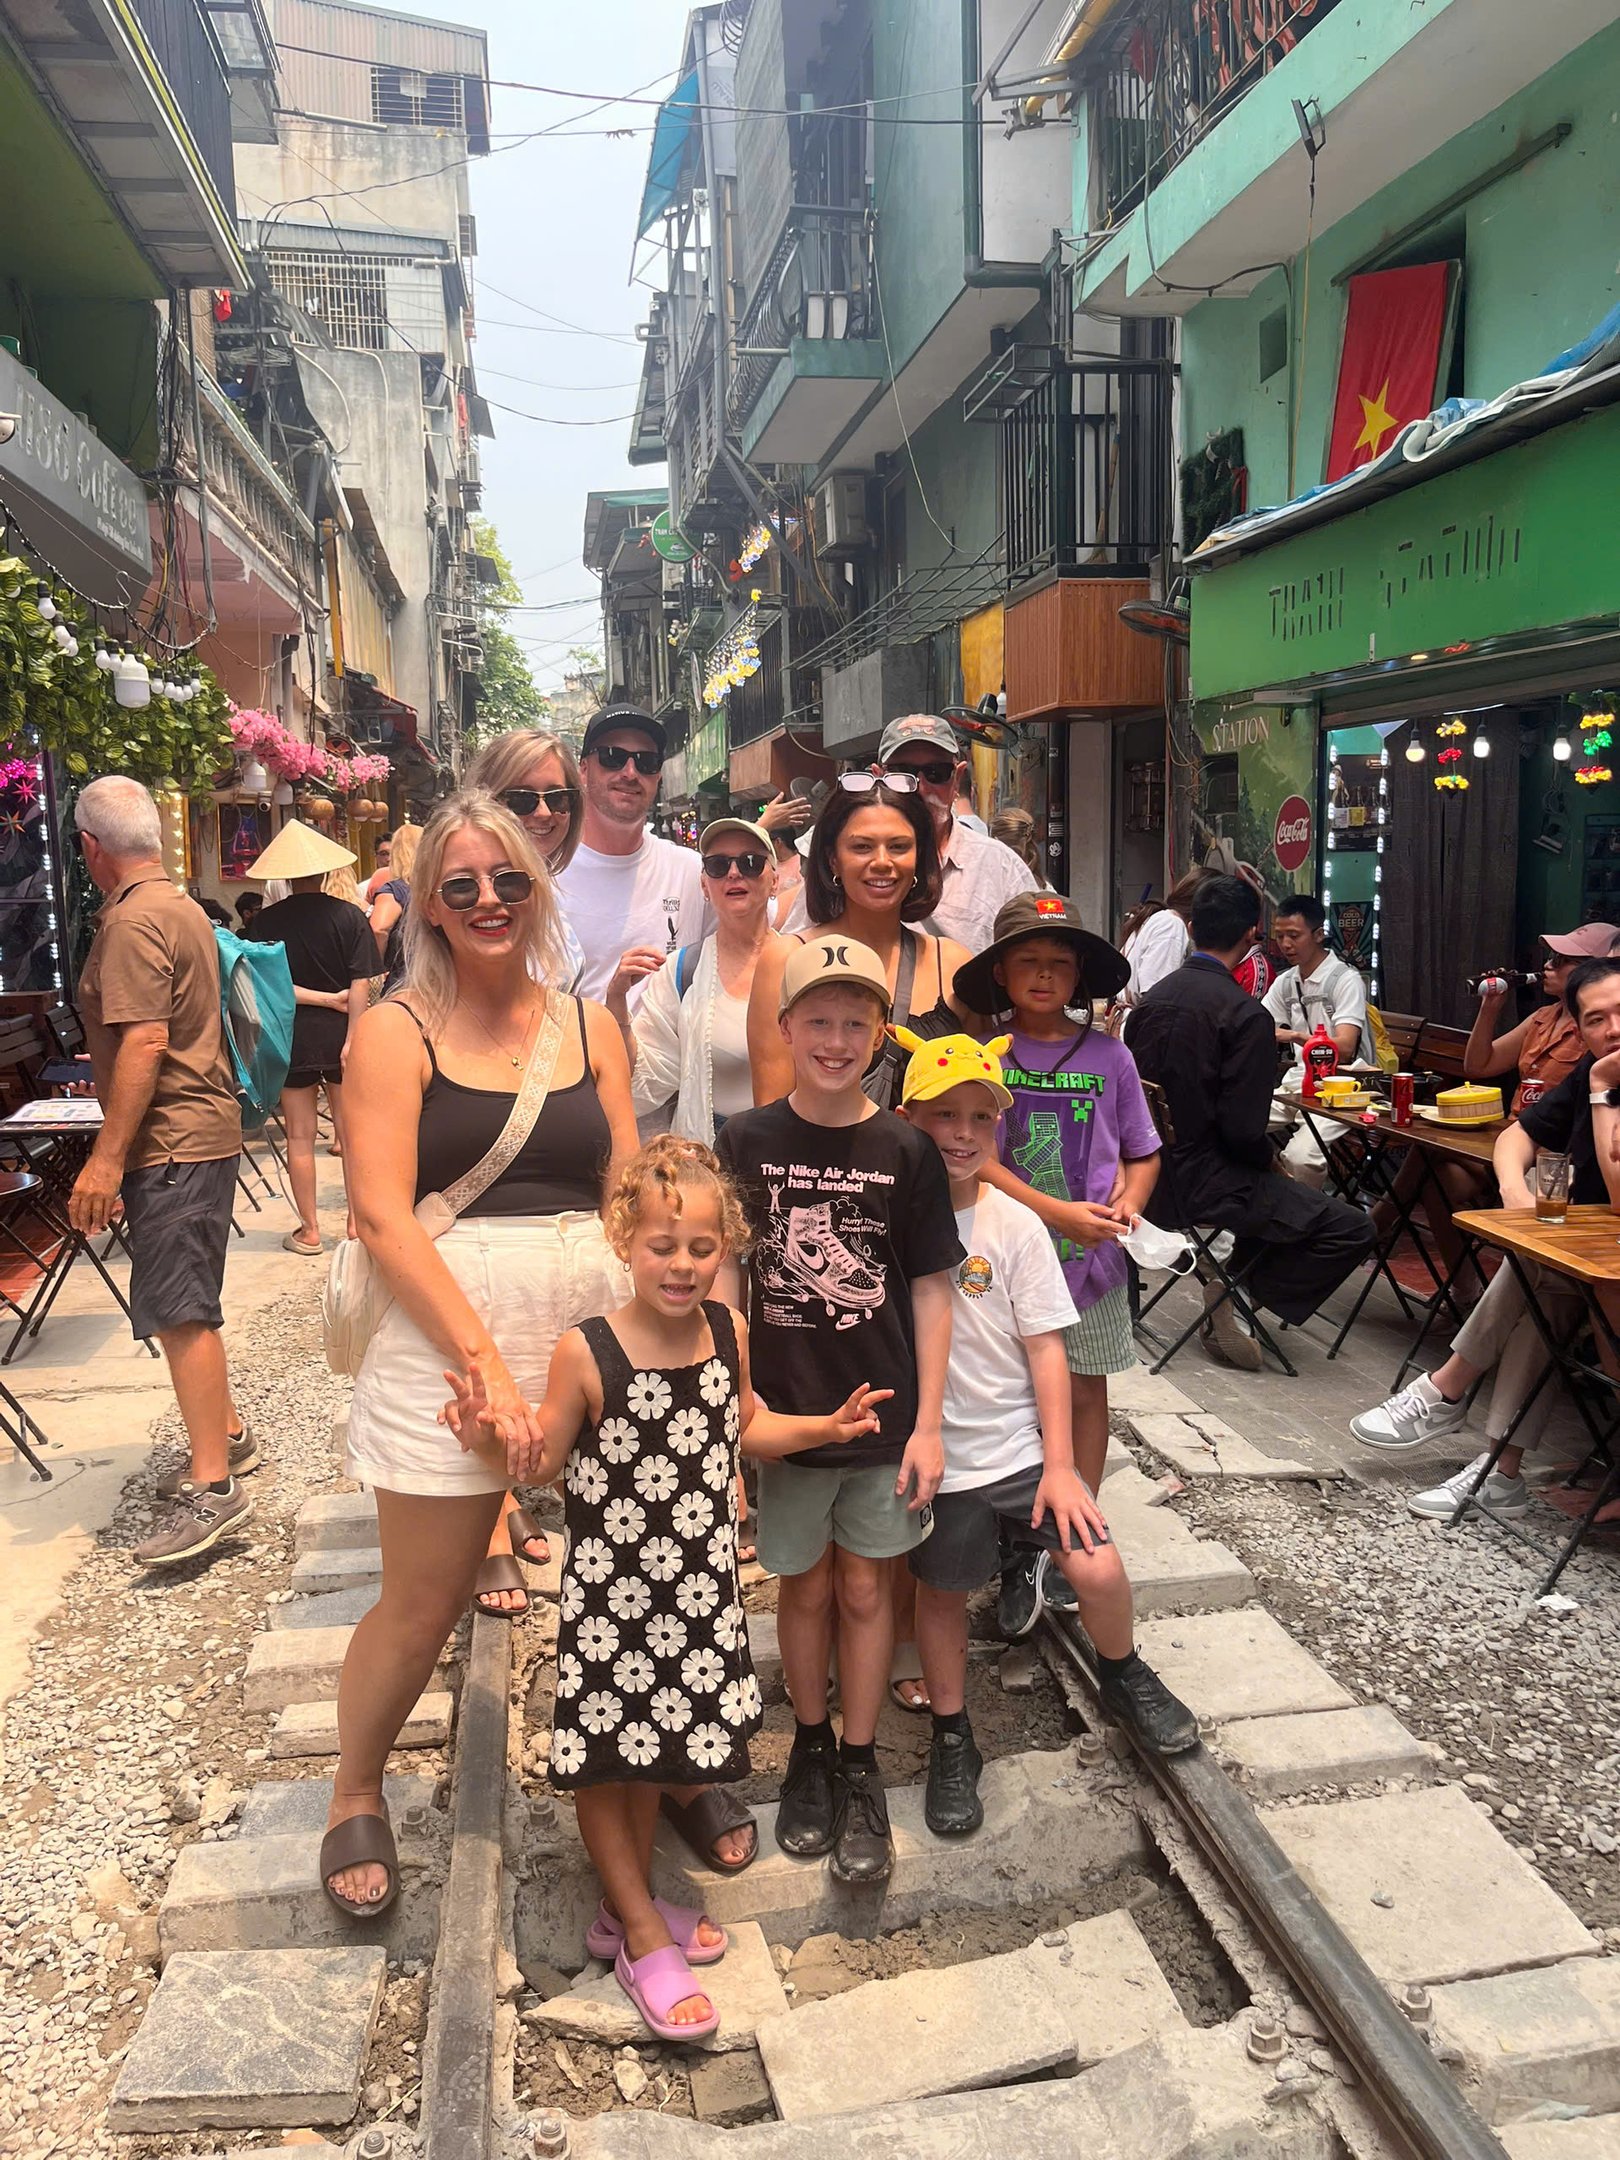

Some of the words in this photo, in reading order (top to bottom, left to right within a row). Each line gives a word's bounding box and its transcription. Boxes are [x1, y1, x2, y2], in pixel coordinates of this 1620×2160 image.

[1212, 716, 1271, 752] STATION
[1038, 912, 1068, 920] VIETNAM
[1338, 918, 1365, 928] BEER
[760, 1163, 786, 1176] The
[788, 1164, 821, 1178] Nike
[823, 1166, 844, 1179] Air
[846, 1168, 895, 1185] Jordan
[787, 1176, 814, 1189] has
[816, 1178, 864, 1193] landed
[841, 1216, 864, 1226] Hurry!
[864, 1217, 886, 1228] These
[838, 1224, 861, 1233] Shoes
[873, 1226, 888, 1236] Fly!
[839, 1313, 861, 1324] NIKE
[194, 1506, 220, 1526] N
